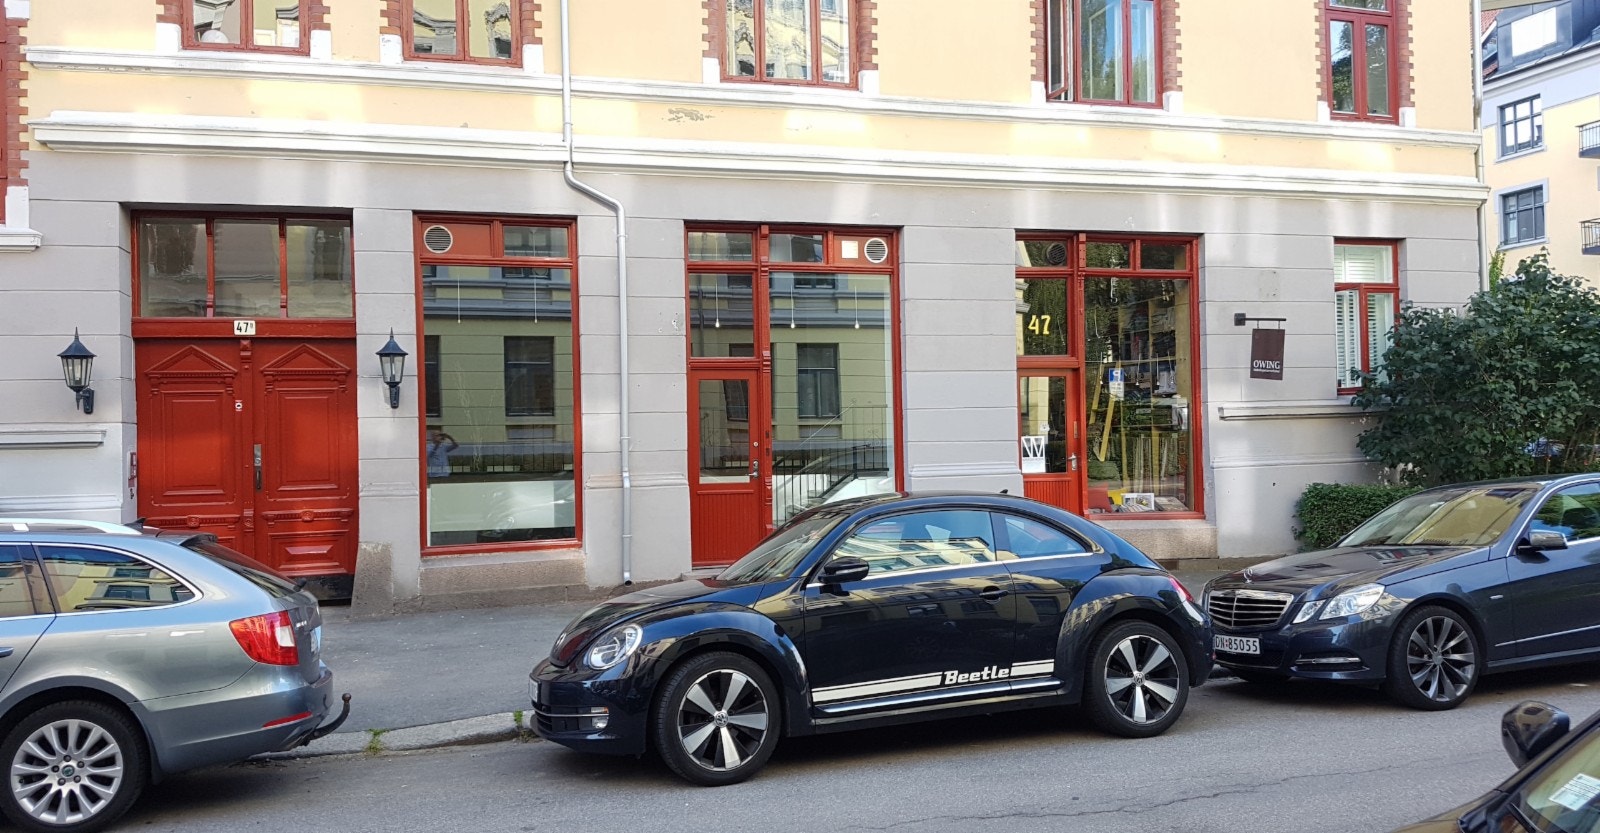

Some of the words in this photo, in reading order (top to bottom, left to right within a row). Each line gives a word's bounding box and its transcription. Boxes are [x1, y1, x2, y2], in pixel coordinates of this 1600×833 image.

[1028, 314, 1051, 335] 47
[1253, 359, 1281, 370] OWING
[944, 665, 1010, 685] Beetle
